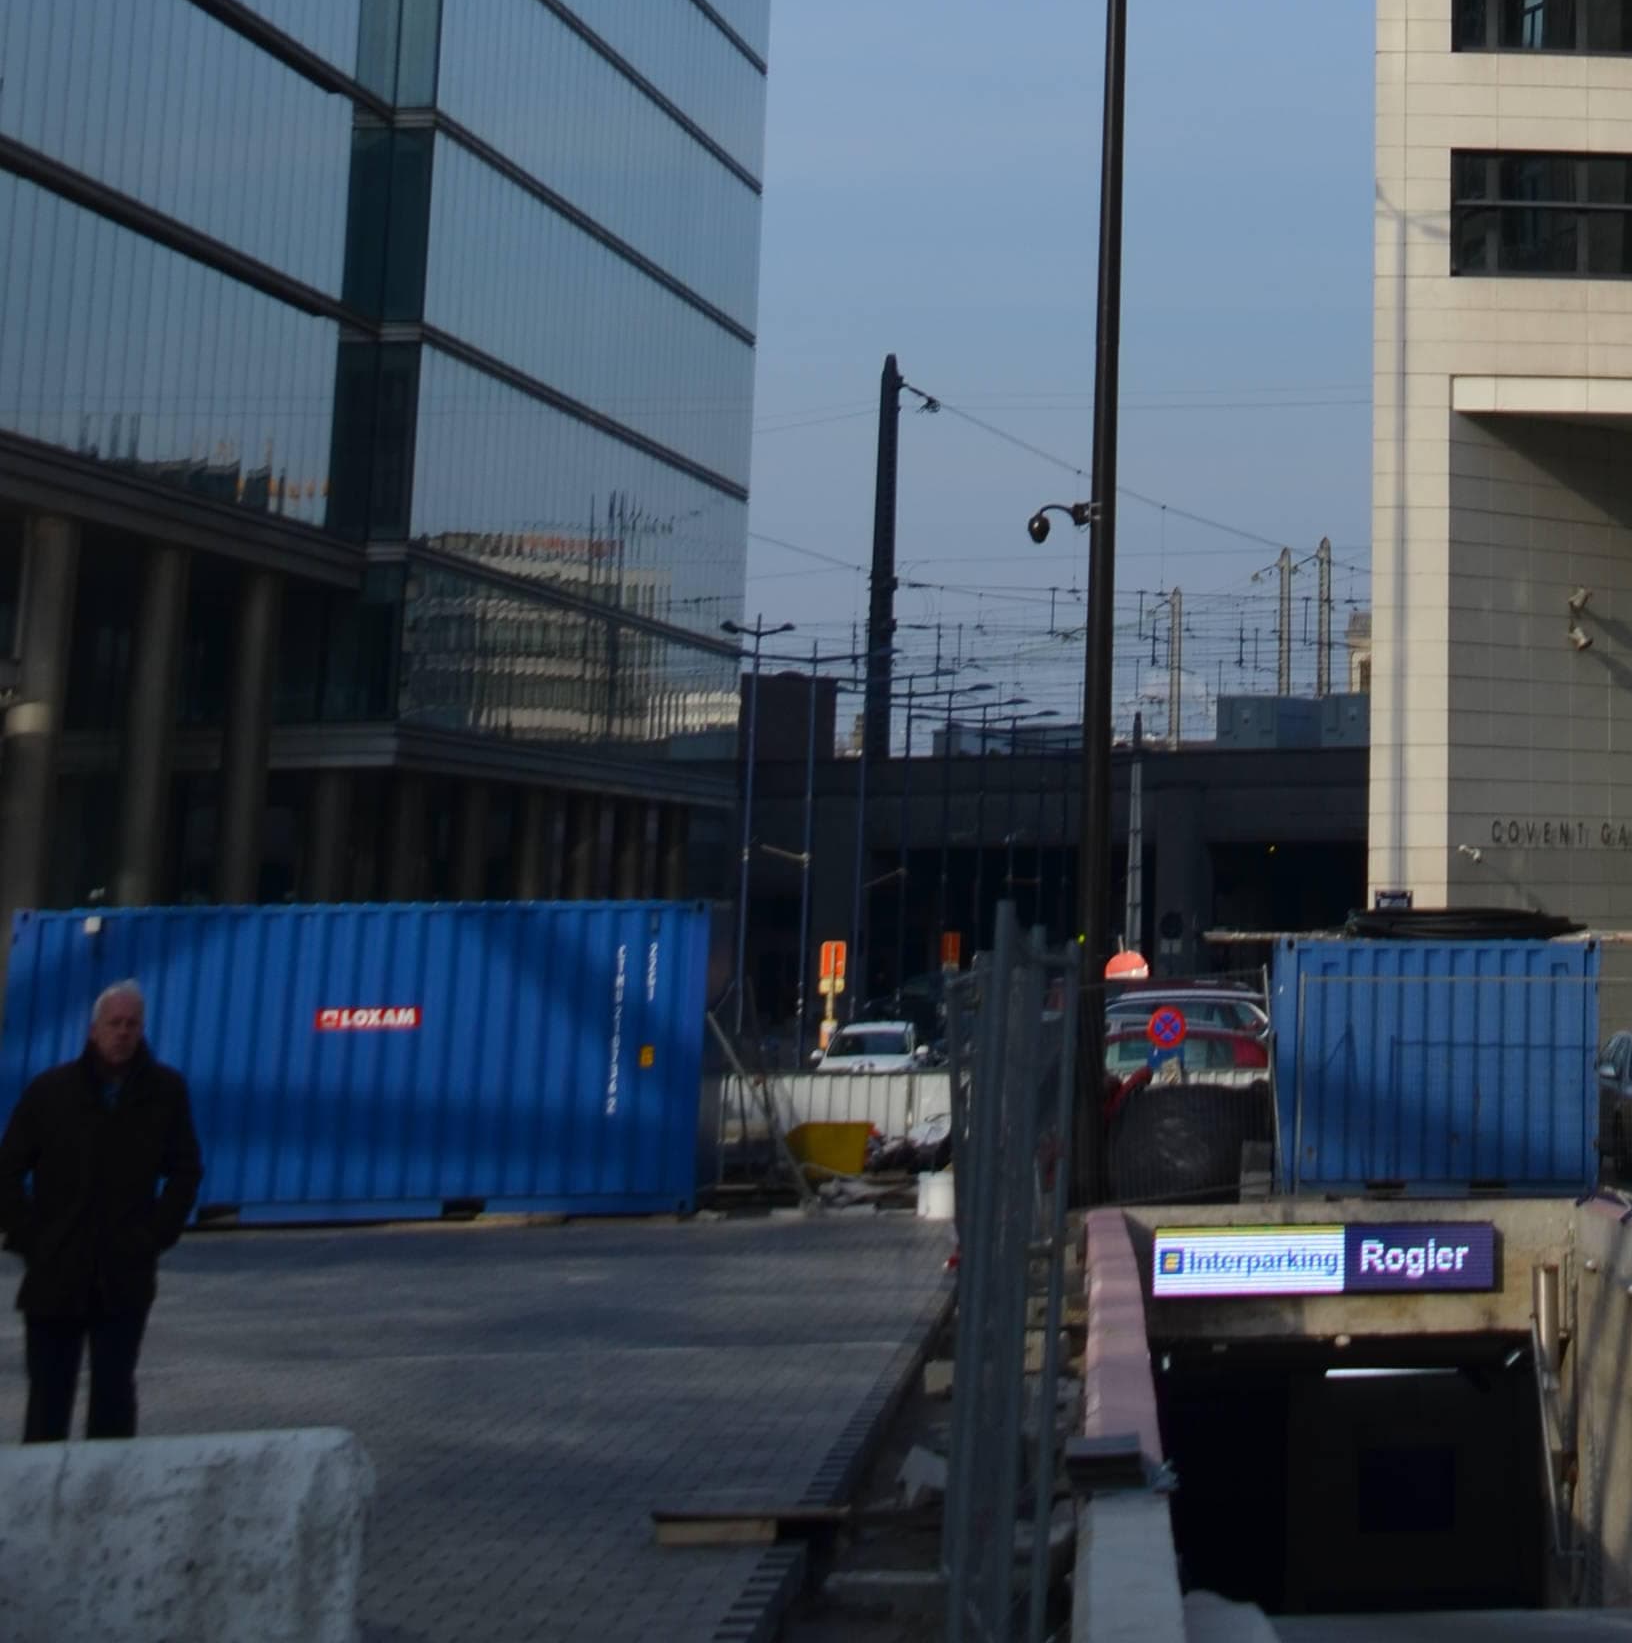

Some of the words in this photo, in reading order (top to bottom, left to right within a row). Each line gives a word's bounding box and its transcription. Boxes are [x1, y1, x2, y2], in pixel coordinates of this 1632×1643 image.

[1491, 820, 1584, 845] COVENT
[341, 1007, 416, 1027] LOXAM
[1190, 1248, 1339, 1278] Interparking
[1361, 1238, 1470, 1278] Rogier
